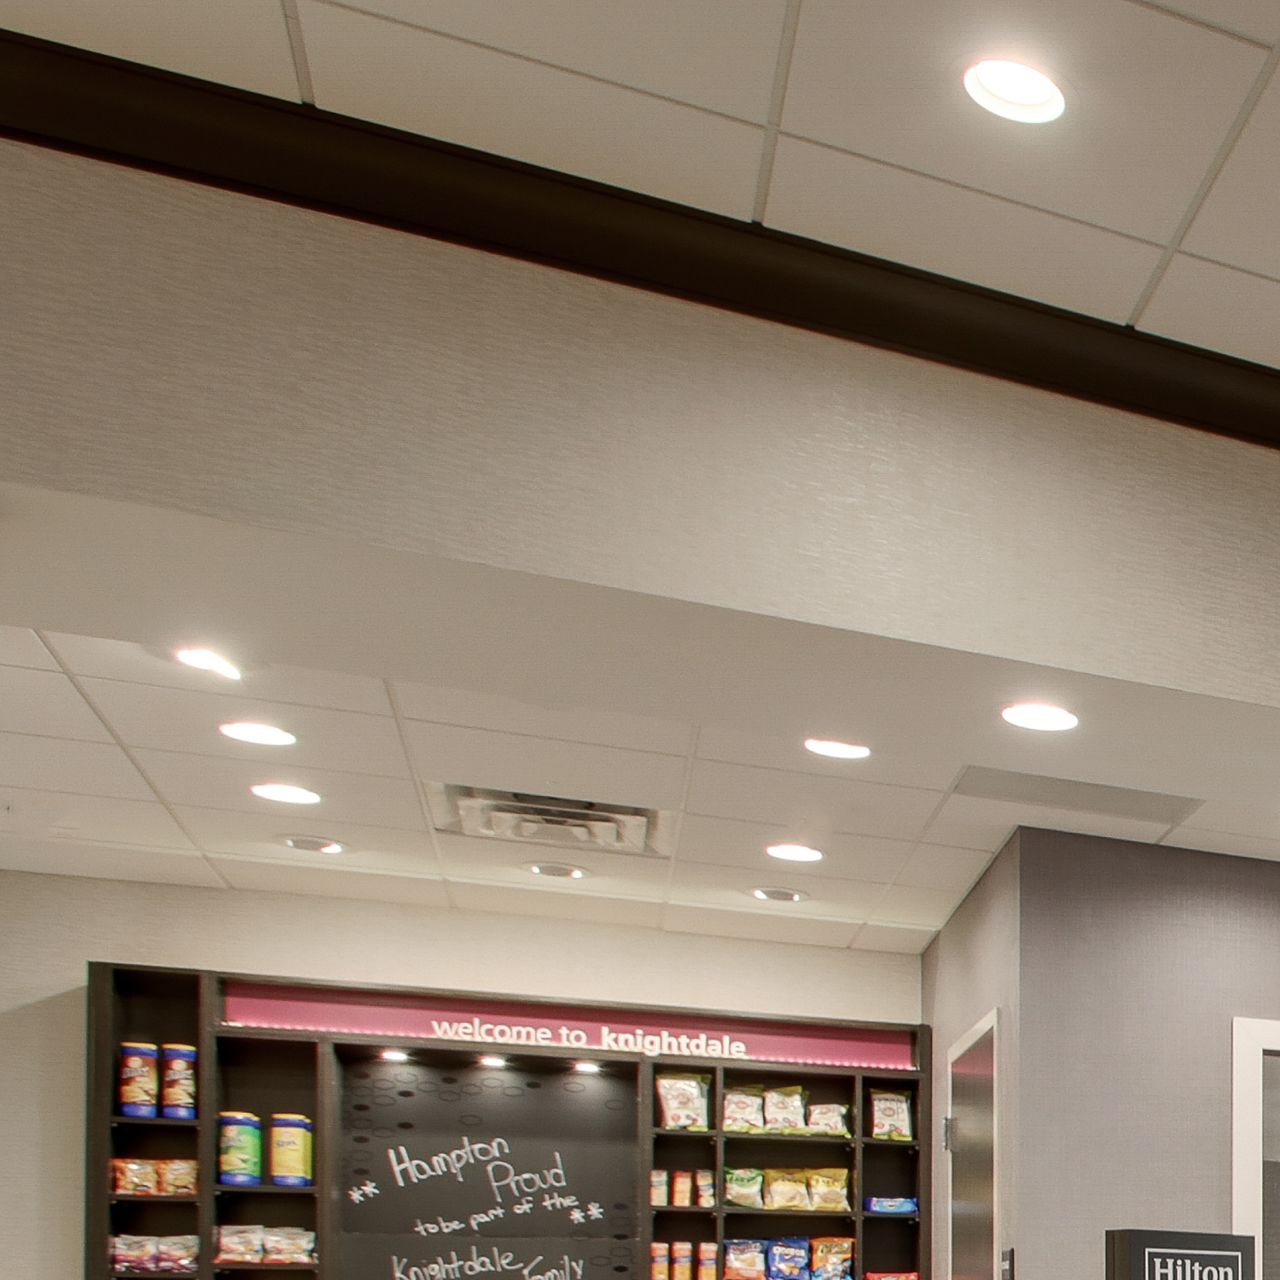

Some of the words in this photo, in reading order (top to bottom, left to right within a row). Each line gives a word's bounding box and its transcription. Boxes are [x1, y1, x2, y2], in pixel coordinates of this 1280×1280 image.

[431, 1018, 552, 1045] welcome
[561, 1026, 587, 1046] to
[601, 1026, 747, 1057] knightdale
[387, 1135, 510, 1187] Hampton
[486, 1151, 567, 1203] Proud
[469, 1206, 505, 1230] part
[513, 1196, 534, 1214] of
[542, 1191, 579, 1211] the
